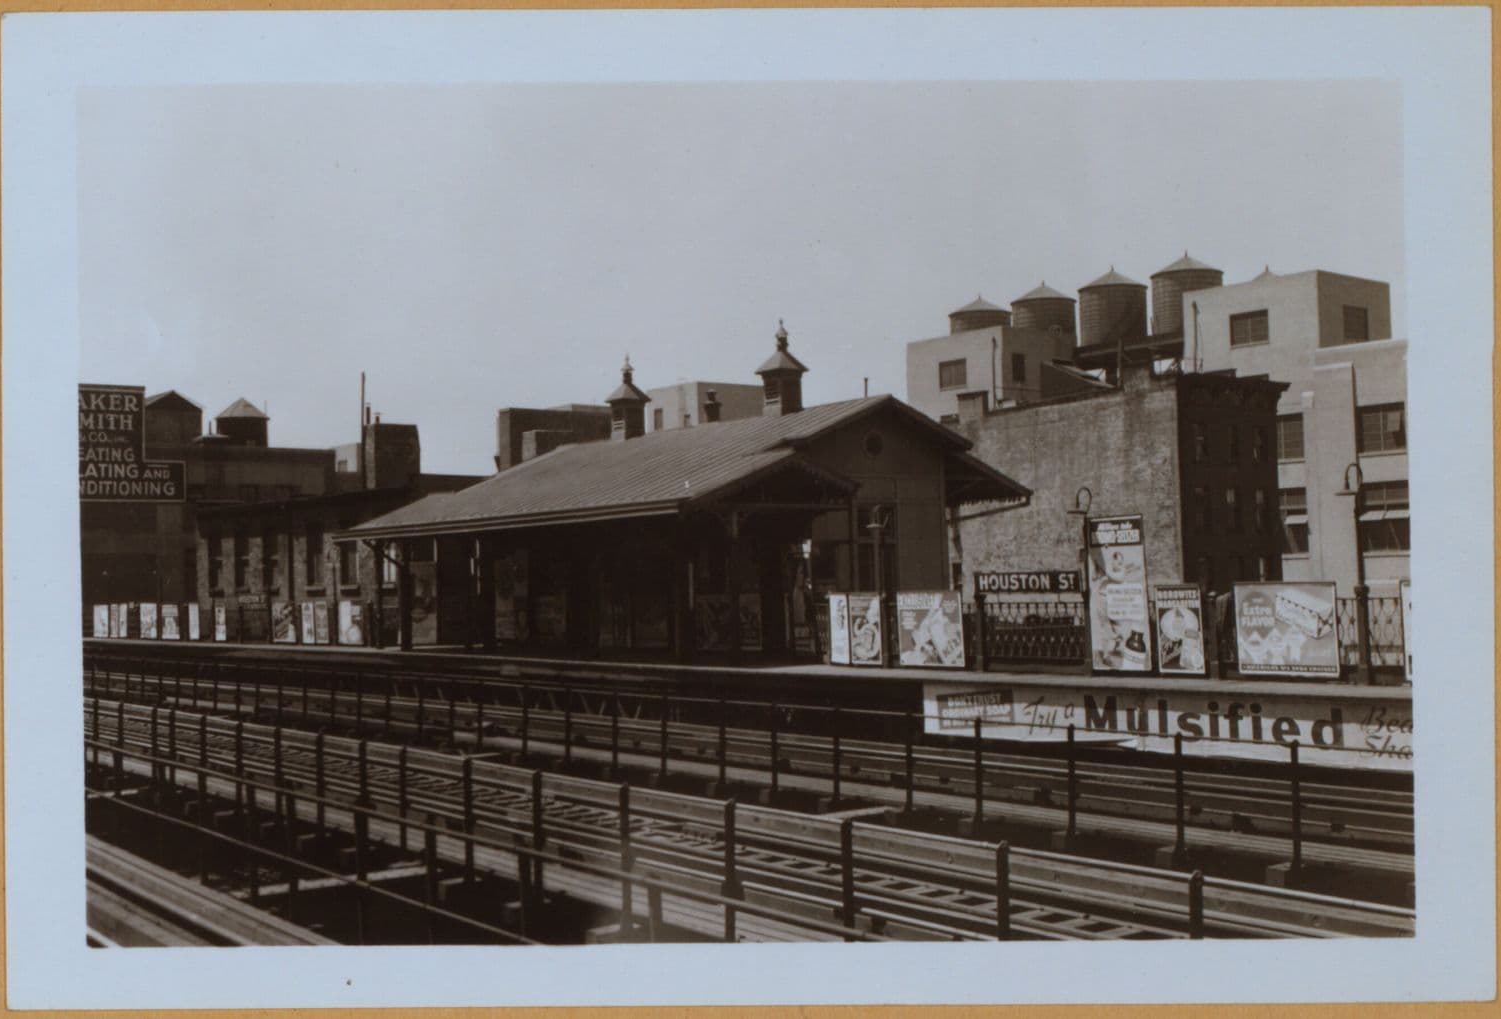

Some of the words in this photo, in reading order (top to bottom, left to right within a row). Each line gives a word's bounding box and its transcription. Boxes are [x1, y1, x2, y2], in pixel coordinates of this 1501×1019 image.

[143, 469, 171, 480] AND
[978, 573, 1051, 591] HOUSTON
[1084, 695, 1346, 749] Mulsified
